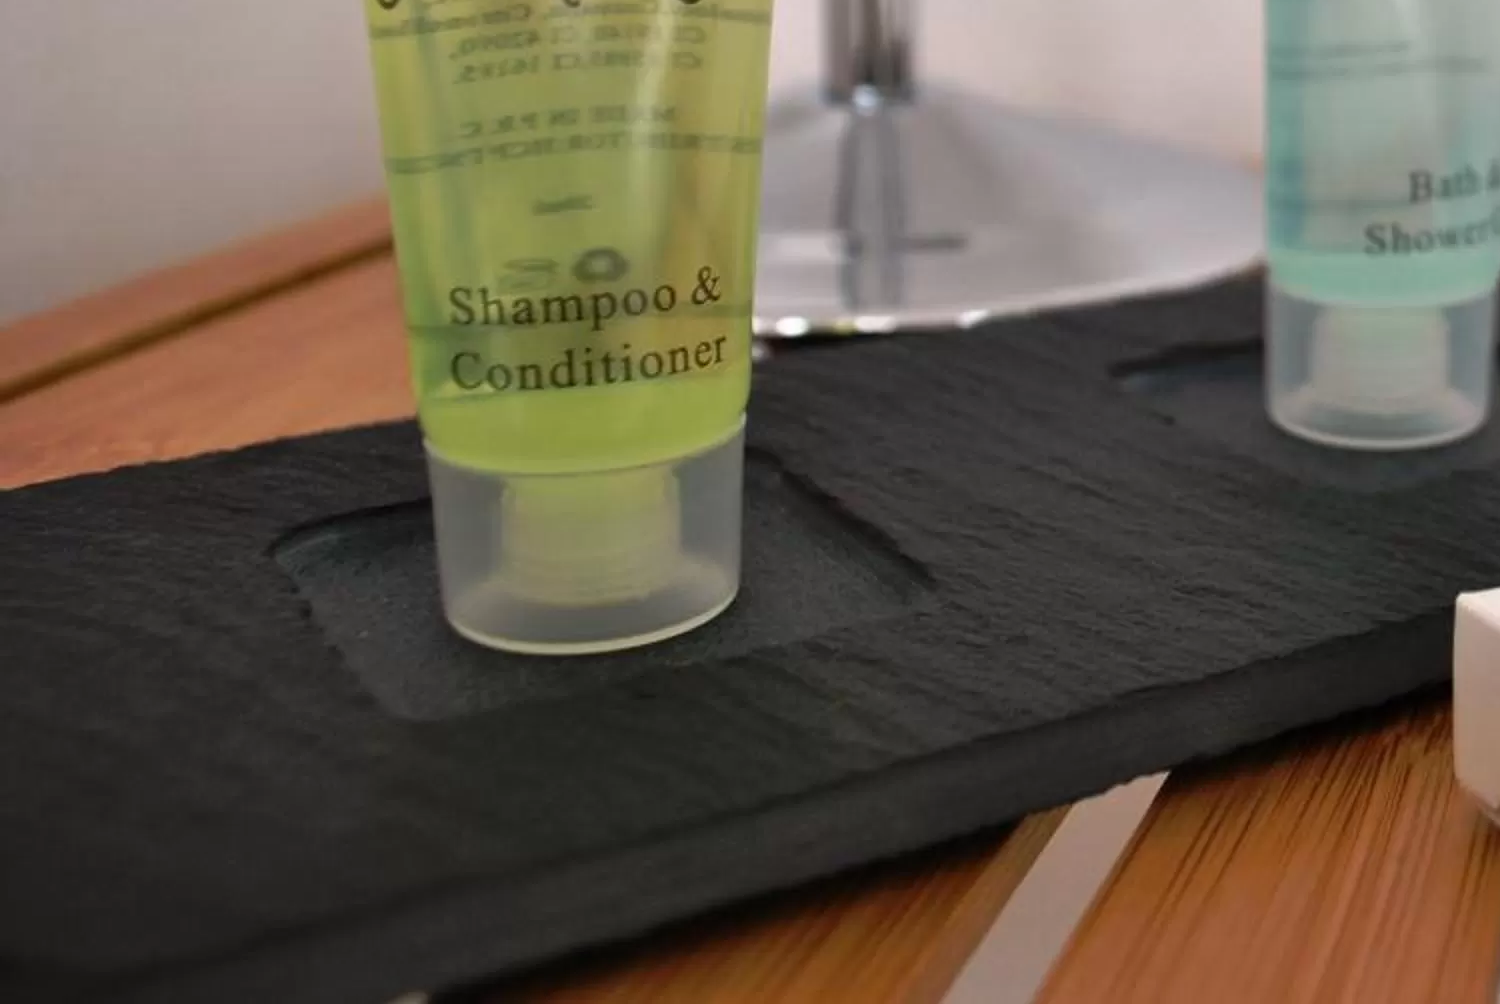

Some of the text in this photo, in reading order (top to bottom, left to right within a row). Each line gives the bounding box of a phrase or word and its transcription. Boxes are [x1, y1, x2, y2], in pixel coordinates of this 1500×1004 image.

[1408, 163, 1483, 206] Bath
[448, 265, 722, 331] Shampoo &
[450, 335, 728, 392] Conditioner
